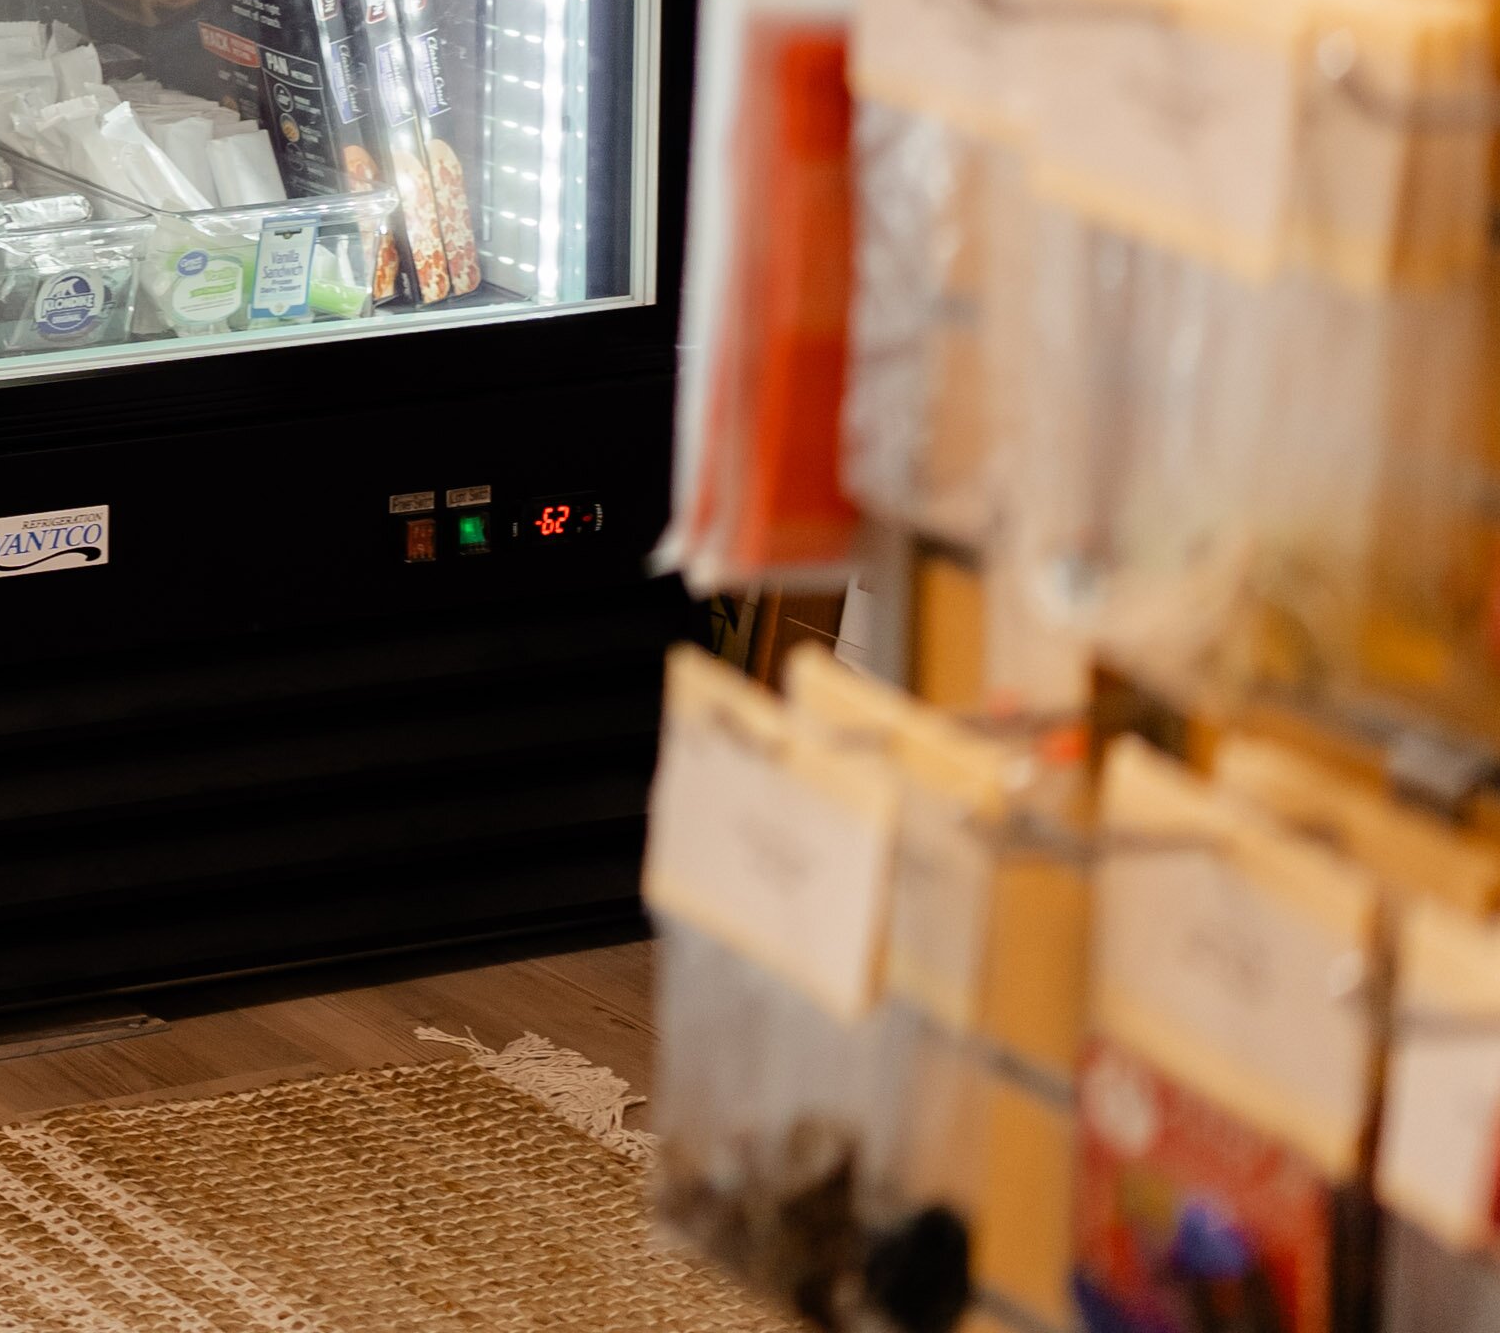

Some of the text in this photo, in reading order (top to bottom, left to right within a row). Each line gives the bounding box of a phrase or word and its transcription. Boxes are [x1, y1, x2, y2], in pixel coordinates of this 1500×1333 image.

[266, 53, 289, 76] PAN
[270, 250, 299, 266] Vanilla
[262, 265, 303, 280] Sandwich
[44, 294, 94, 311] KLONDIKE
[22, 512, 103, 530] REFRIGERATION
